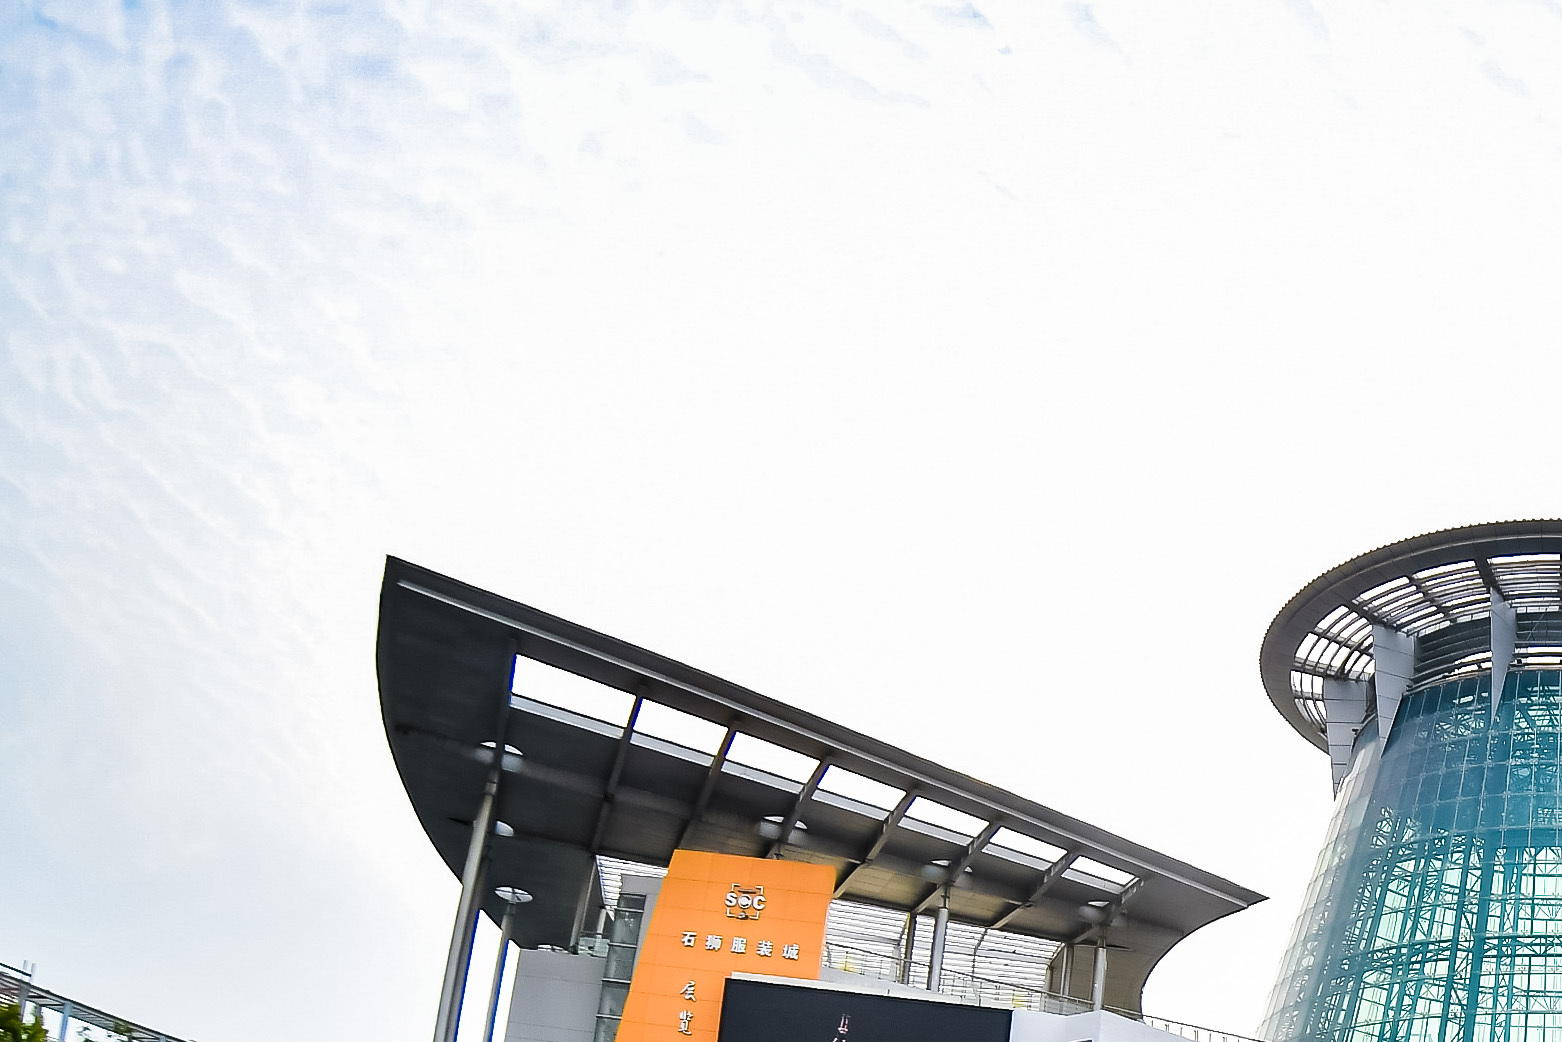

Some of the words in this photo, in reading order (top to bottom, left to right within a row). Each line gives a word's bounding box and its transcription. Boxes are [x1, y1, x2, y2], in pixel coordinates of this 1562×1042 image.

[681, 930, 800, 960] 石狮服装城
